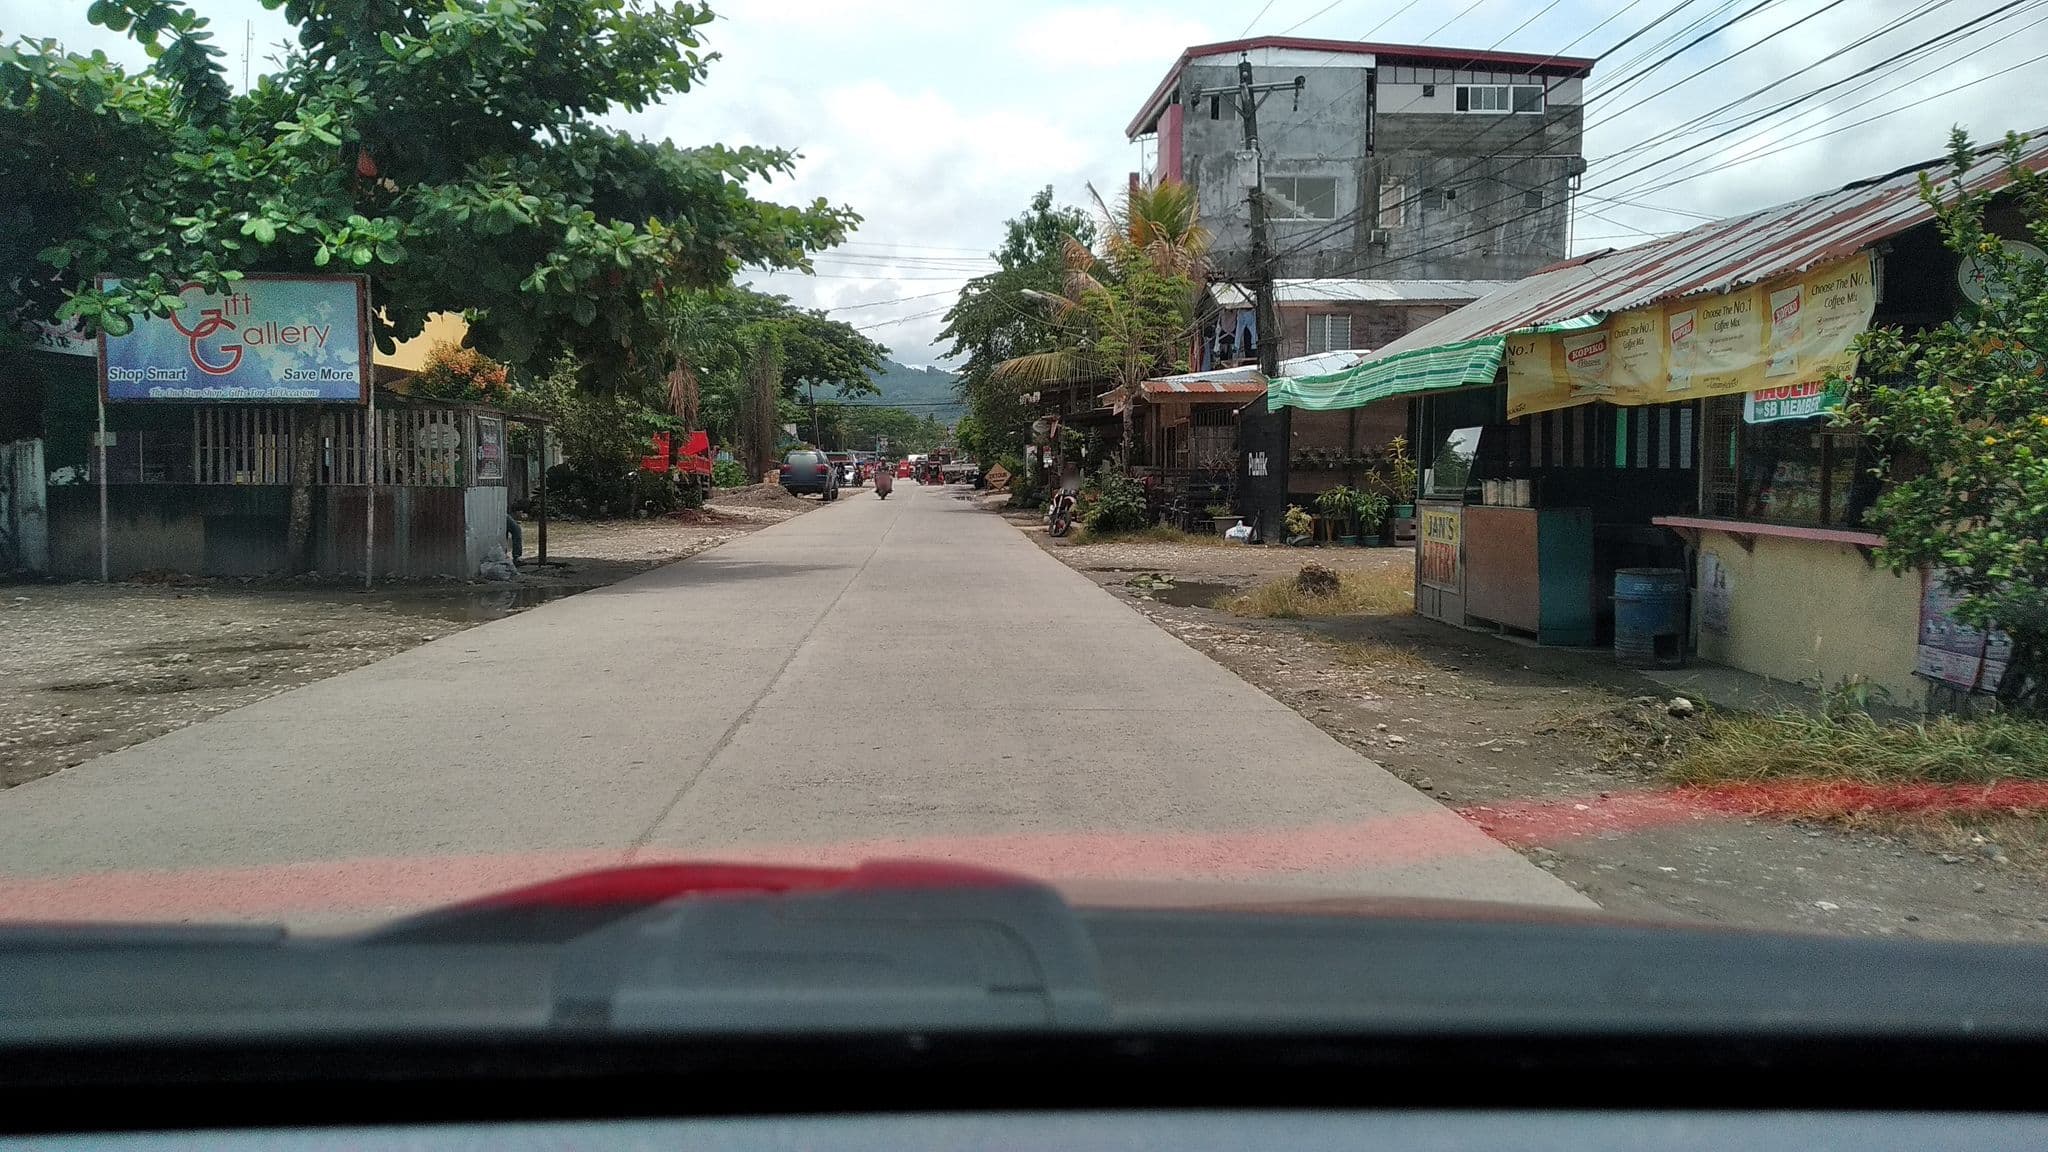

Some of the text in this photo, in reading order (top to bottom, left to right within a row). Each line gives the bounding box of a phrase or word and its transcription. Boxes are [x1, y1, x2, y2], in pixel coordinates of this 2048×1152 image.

[1836, 278, 1848, 290] The
[169, 281, 252, 337] Gift
[1823, 294, 1846, 310] Coffee
[189, 318, 331, 376] Gallery
[1572, 342, 1604, 359] KOPIKO
[109, 368, 187, 381] Shop Smart
[283, 368, 353, 380] Save More
[1764, 401, 1777, 417] SB
[1780, 396, 1821, 416] MEMBER
[1428, 515, 1455, 541] JAN'S
